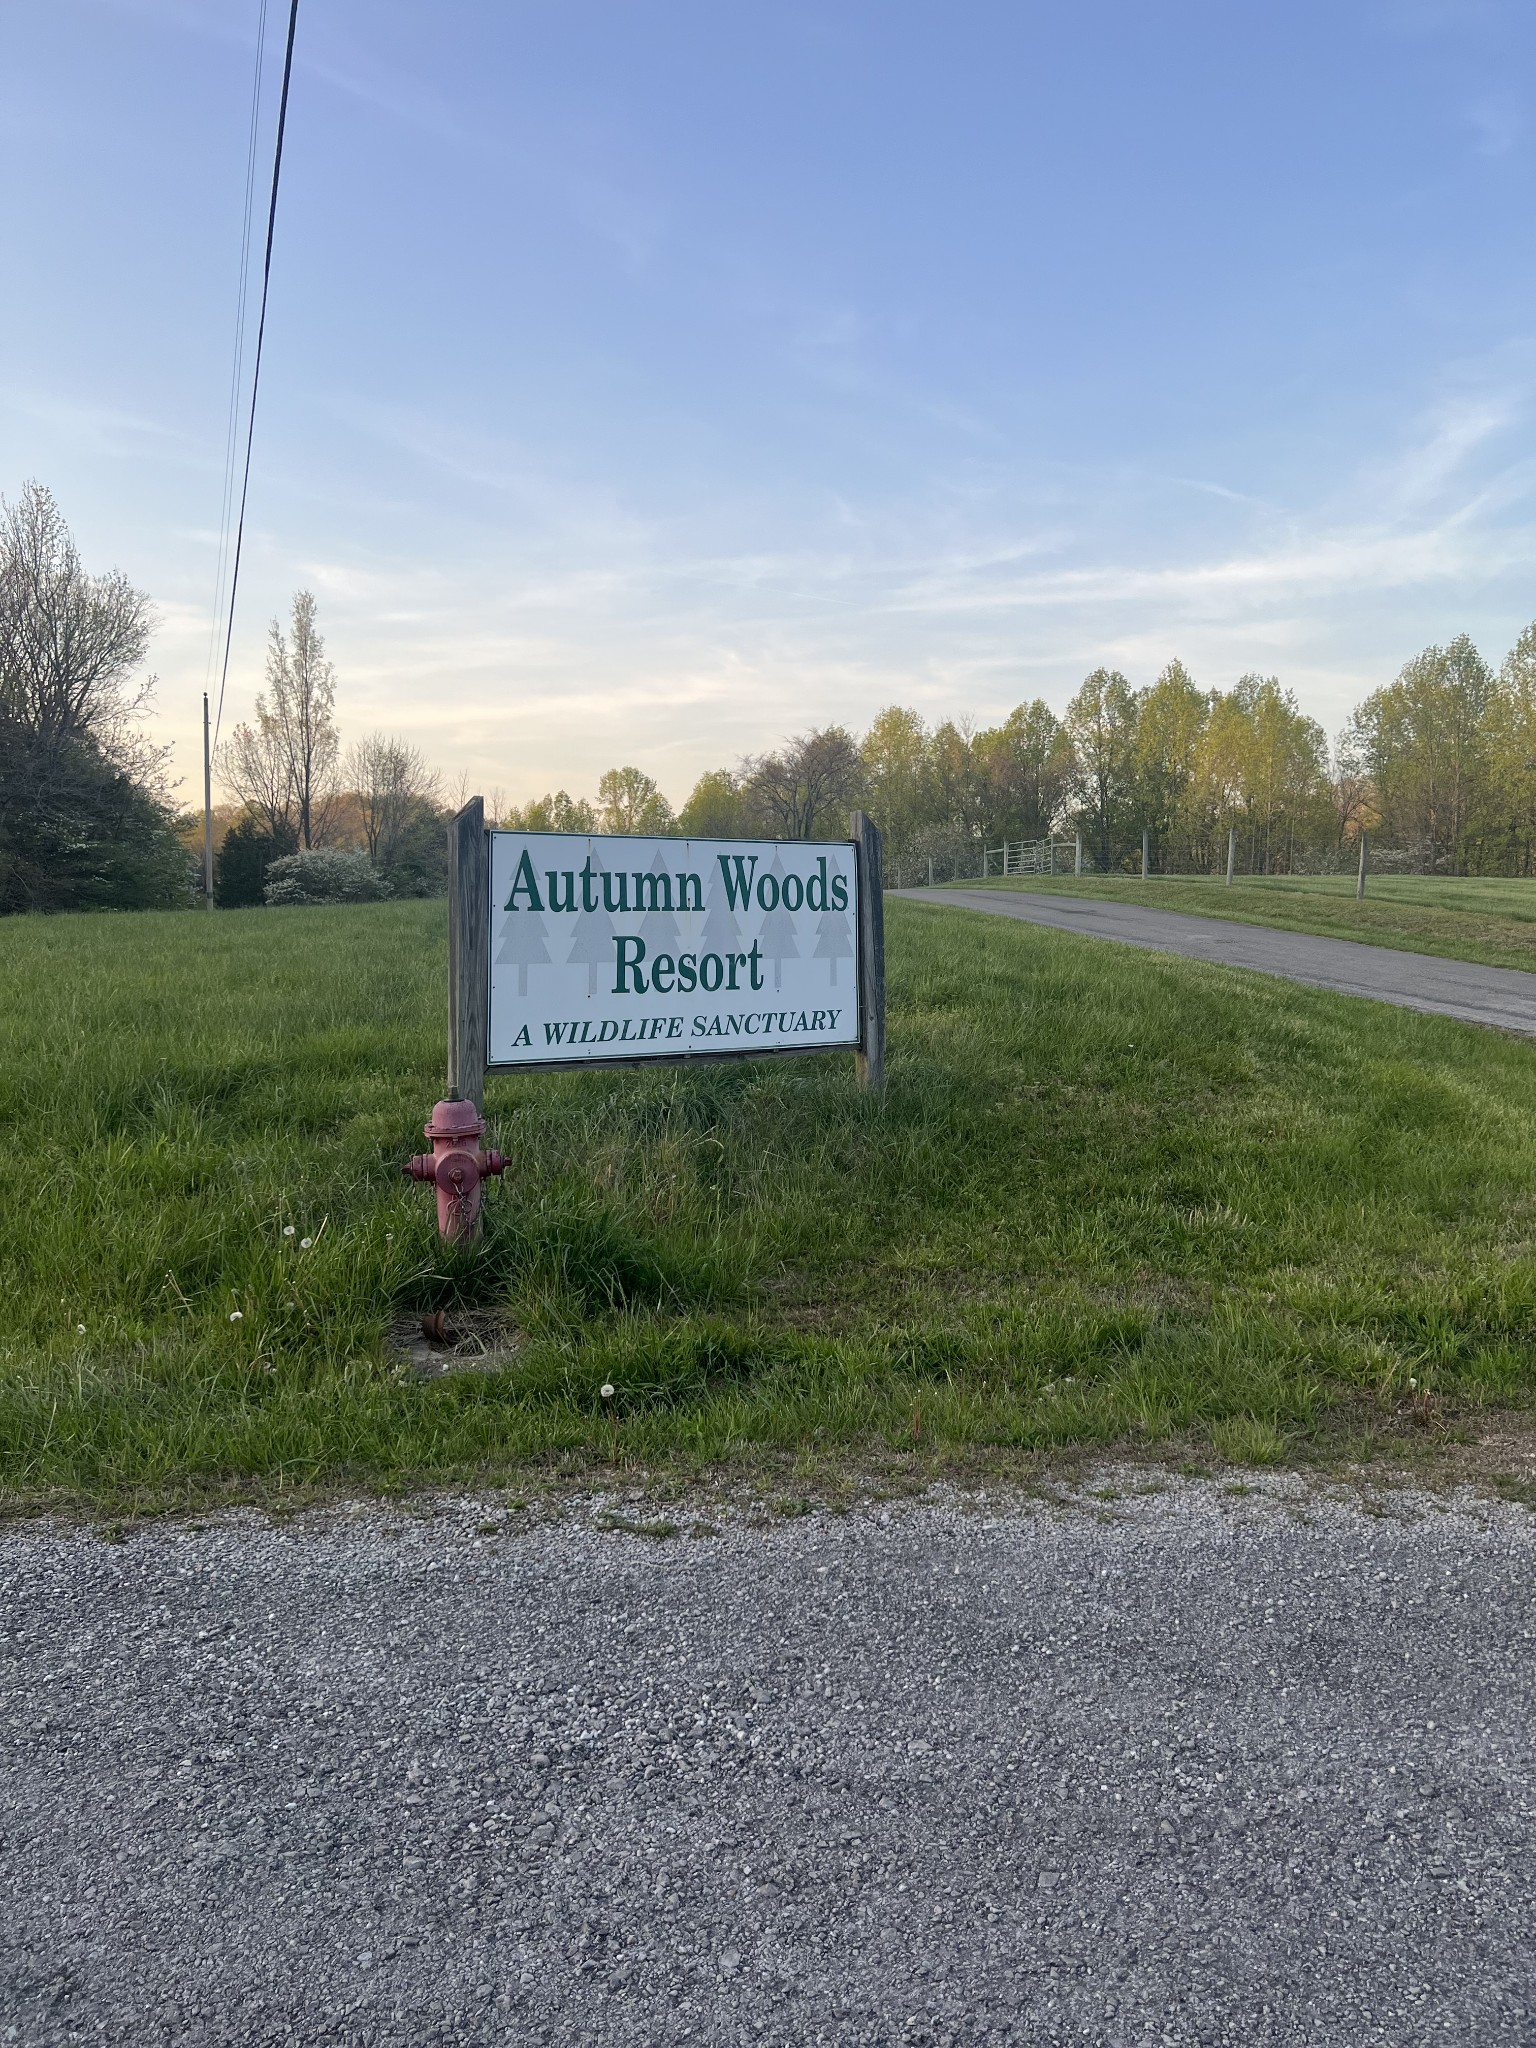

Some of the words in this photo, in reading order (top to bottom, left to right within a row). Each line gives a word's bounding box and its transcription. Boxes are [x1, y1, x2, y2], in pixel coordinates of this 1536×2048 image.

[503, 849, 706, 913] Autumn
[717, 855, 849, 912] Woods
[611, 935, 764, 995] Resort
[512, 1024, 534, 1047] A
[543, 1017, 683, 1045] WILDLIFE
[691, 1009, 842, 1037] SANCTUARY
